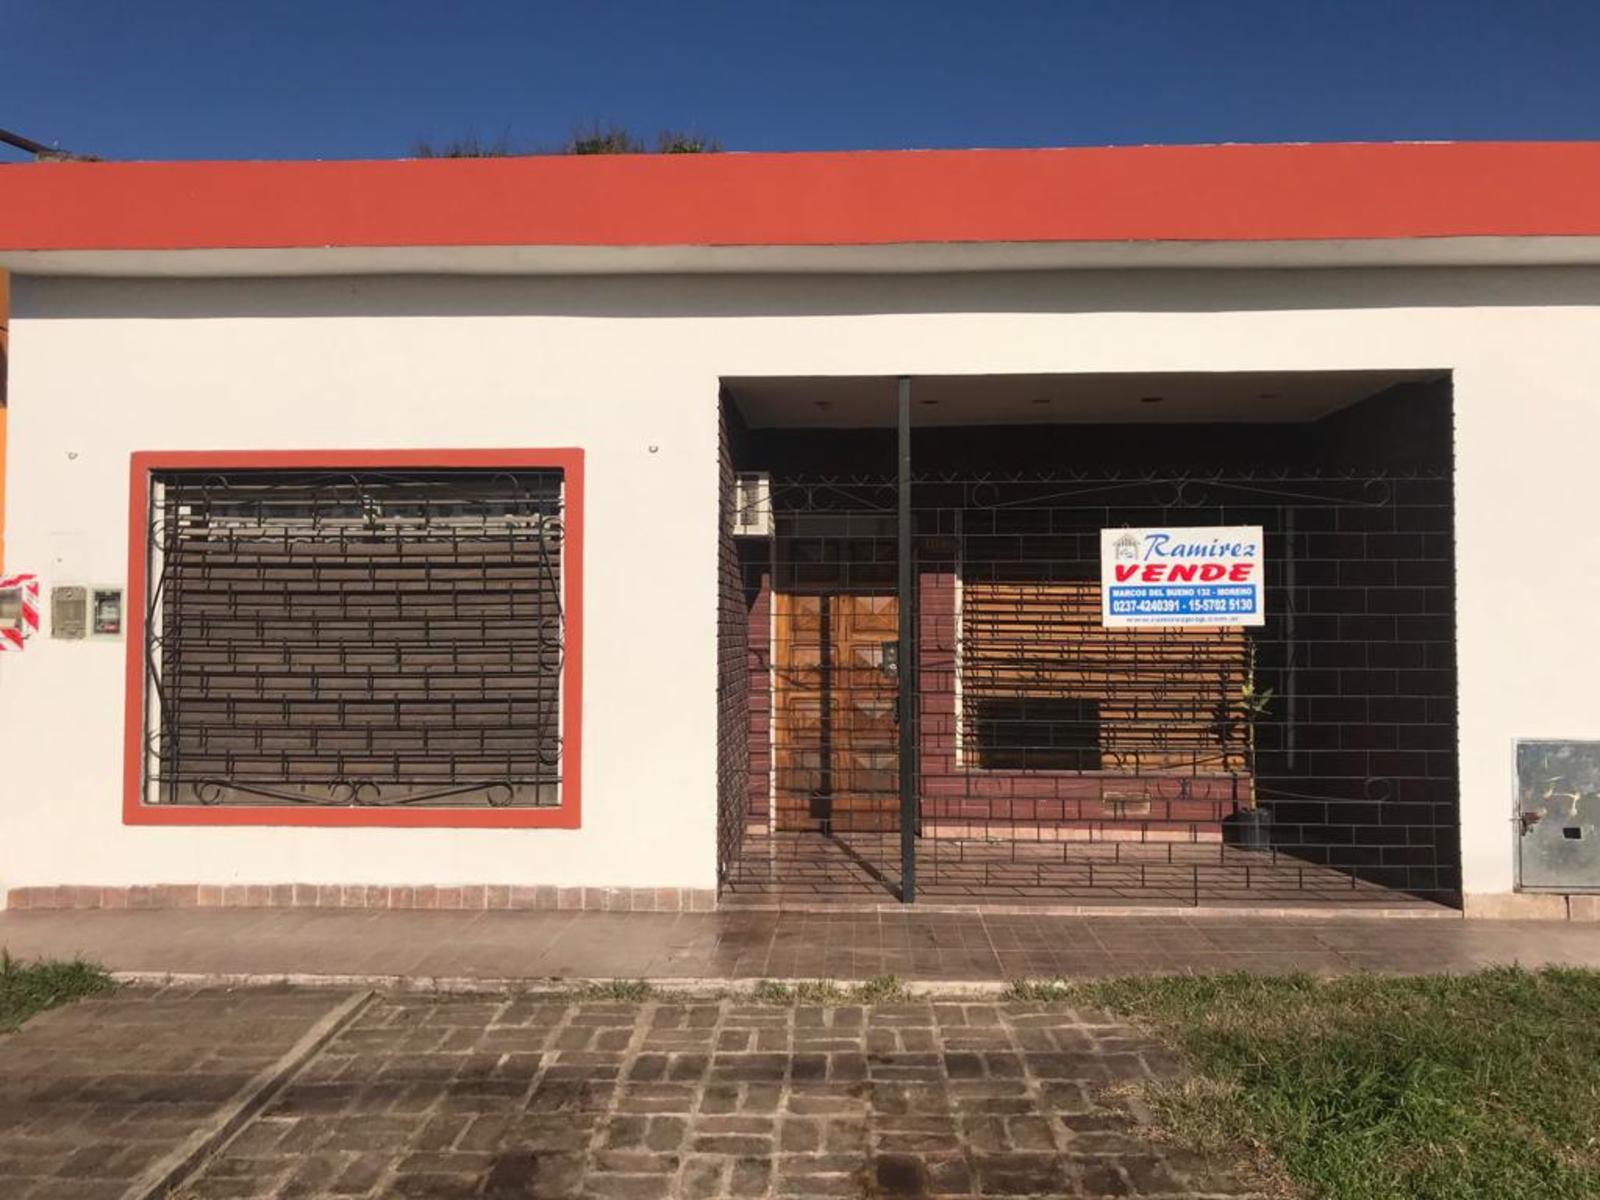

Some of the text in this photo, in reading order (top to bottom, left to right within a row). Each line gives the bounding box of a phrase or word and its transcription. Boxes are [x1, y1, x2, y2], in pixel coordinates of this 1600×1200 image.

[1144, 533, 1256, 561] Ramirez
[1114, 563, 1255, 582] VENDE
[1112, 589, 1147, 597] MARCOS
[1149, 588, 1164, 597] DEL
[1166, 588, 1194, 597] BUENO
[1217, 587, 1252, 596] MORENO
[1228, 598, 1252, 611] 5130
